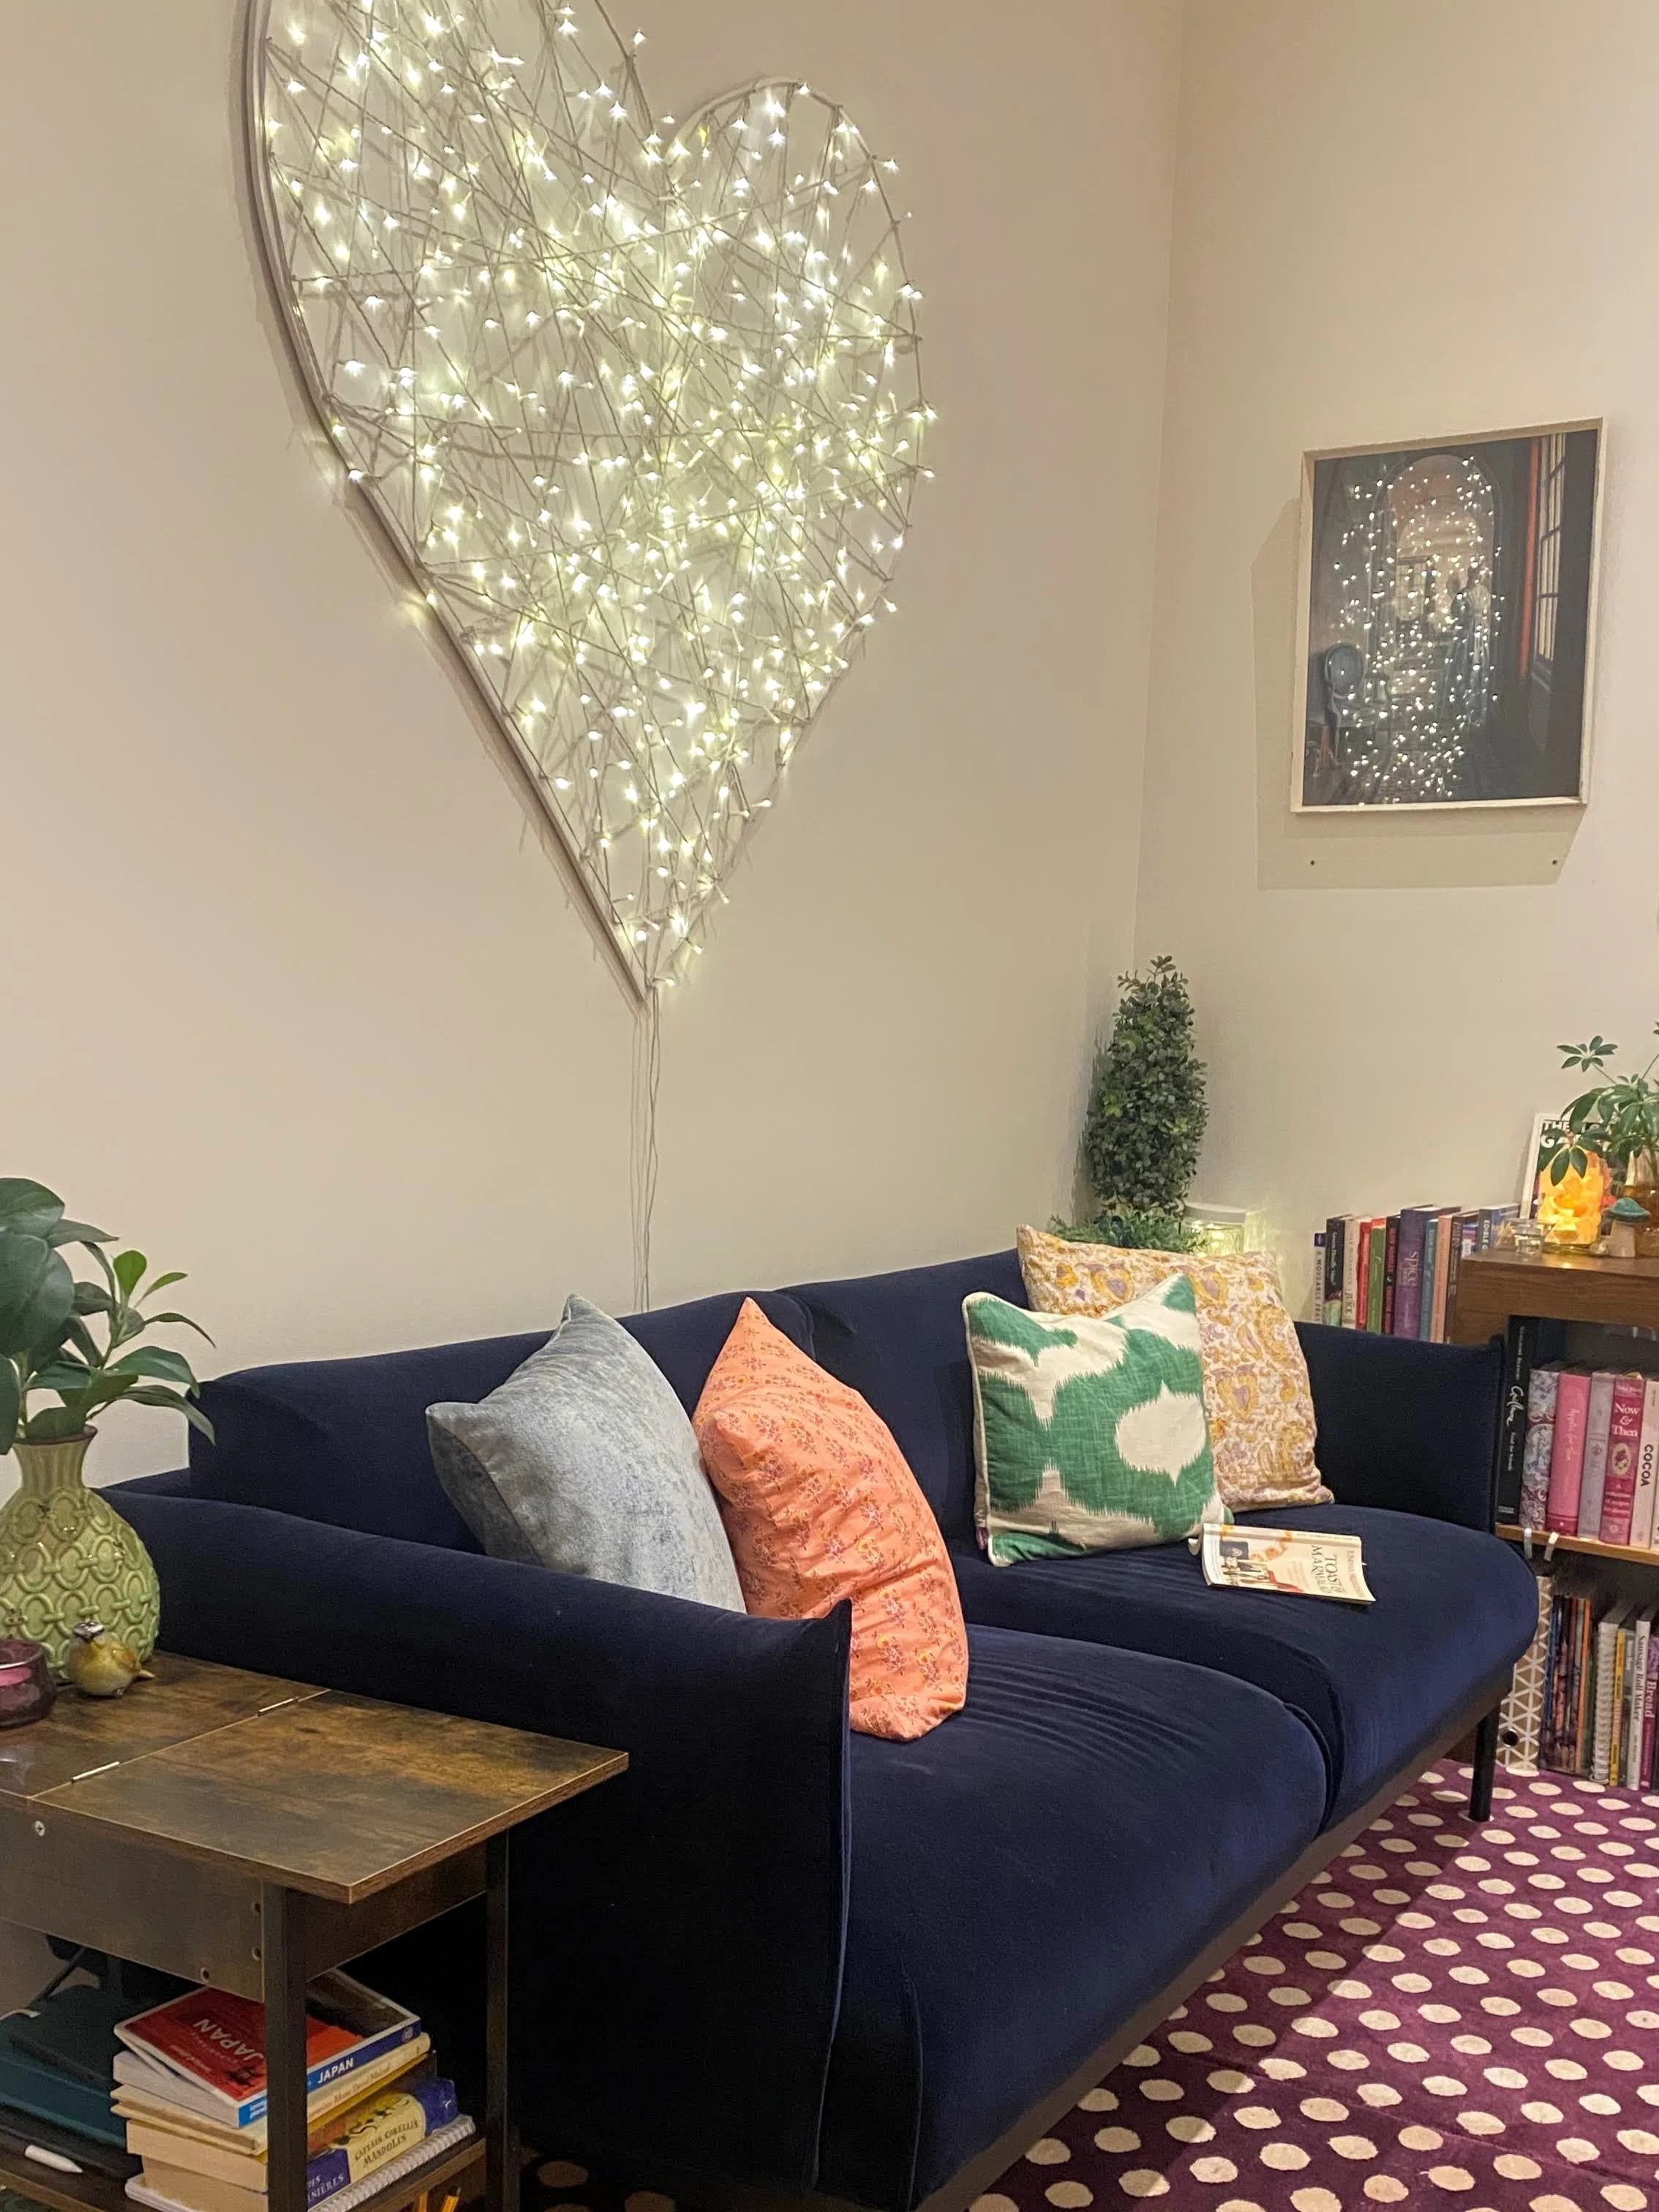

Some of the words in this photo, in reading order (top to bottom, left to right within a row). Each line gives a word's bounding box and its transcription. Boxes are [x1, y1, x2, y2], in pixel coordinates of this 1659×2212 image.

[1543, 1122, 1570, 1132] THE
[1404, 1252, 1419, 1287] spice
[1345, 1292, 1353, 1314] JUICE
[1614, 1402, 1640, 1415] Now
[1620, 1415, 1633, 1426] &
[1611, 1424, 1639, 1437] Then
[1640, 1444, 1654, 1486] COCOA
[1635, 1635, 1647, 1672] Sausage
[1633, 1673, 1644, 1691] Roll
[1633, 1692, 1644, 1721] Maker
[1644, 1681, 1658, 1718] Bread
[192, 2018, 264, 2061] JAPAN
[317, 2057, 354, 2084] JAPAN
[355, 2137, 383, 2161] CAPTAIN
[364, 2134, 407, 2168] MANDOLIN
